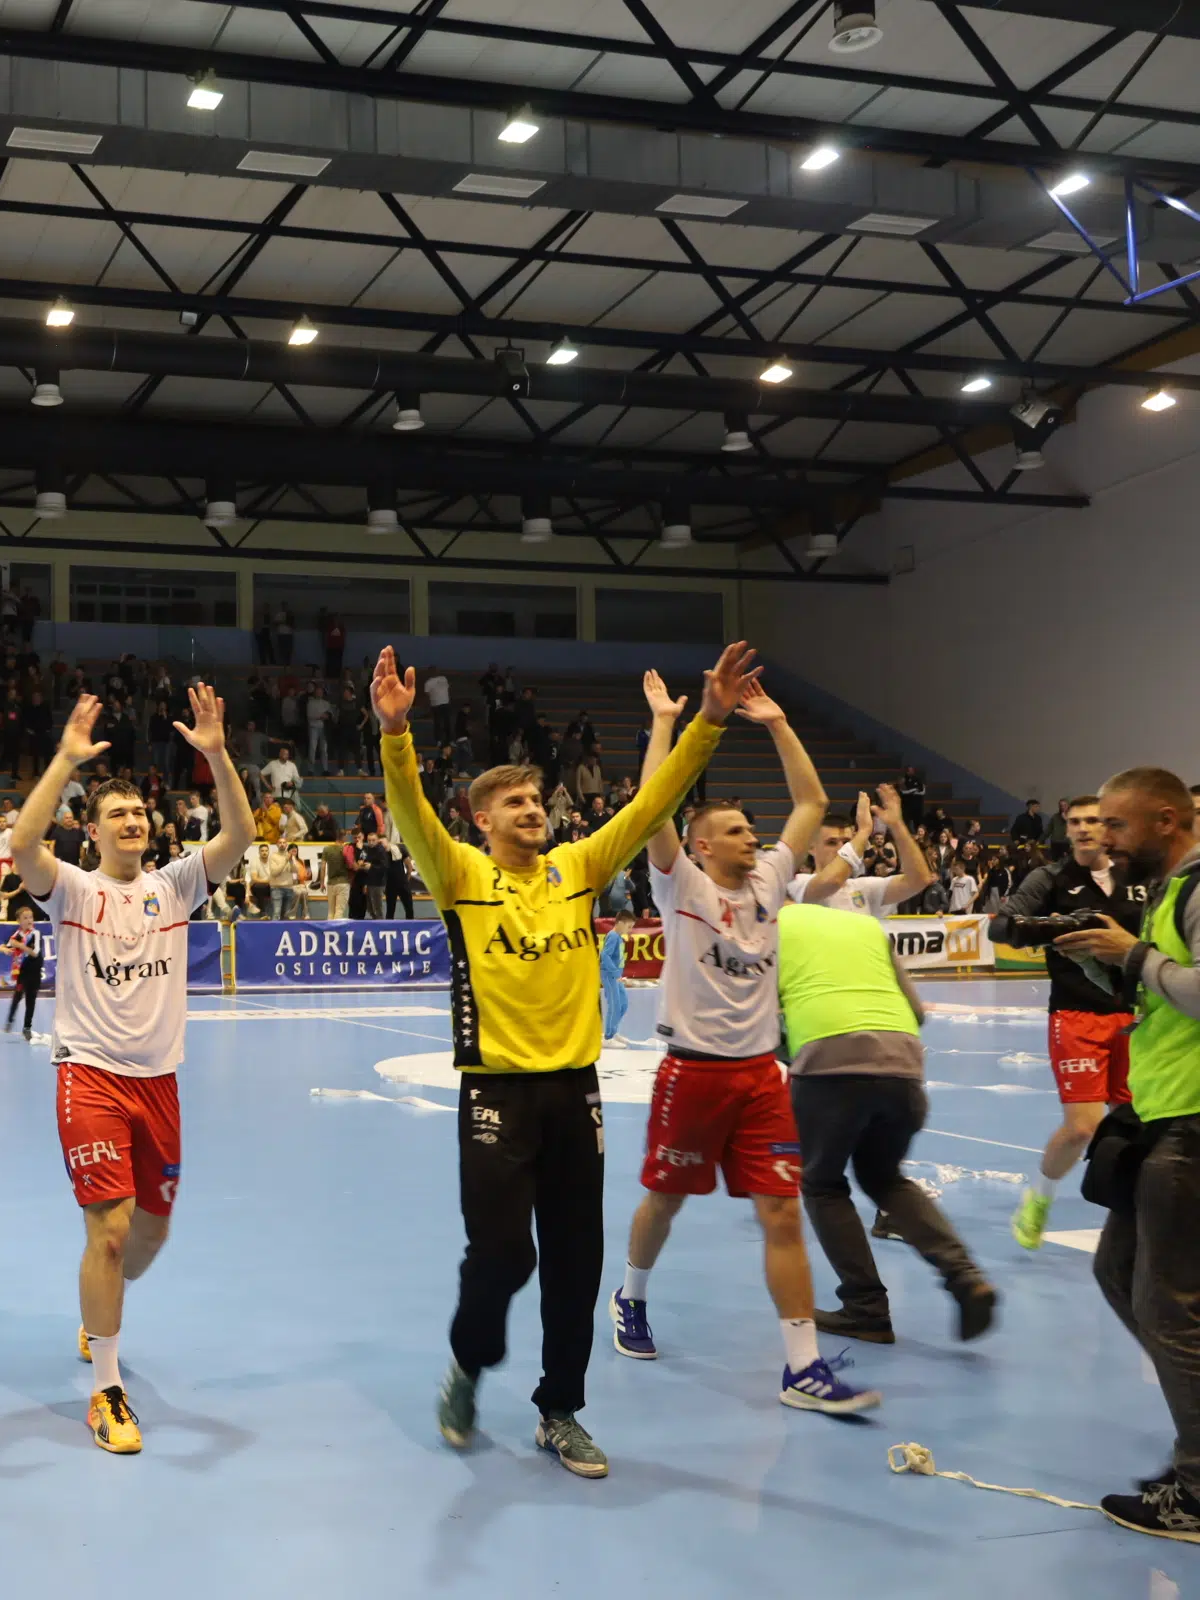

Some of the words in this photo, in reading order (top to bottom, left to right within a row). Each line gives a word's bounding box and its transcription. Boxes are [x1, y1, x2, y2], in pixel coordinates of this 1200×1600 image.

[1126, 885, 1148, 902] 13
[275, 930, 432, 957] ADRIATIC
[275, 960, 432, 976] OSIGURANJE
[471, 1106, 503, 1125] EAL
